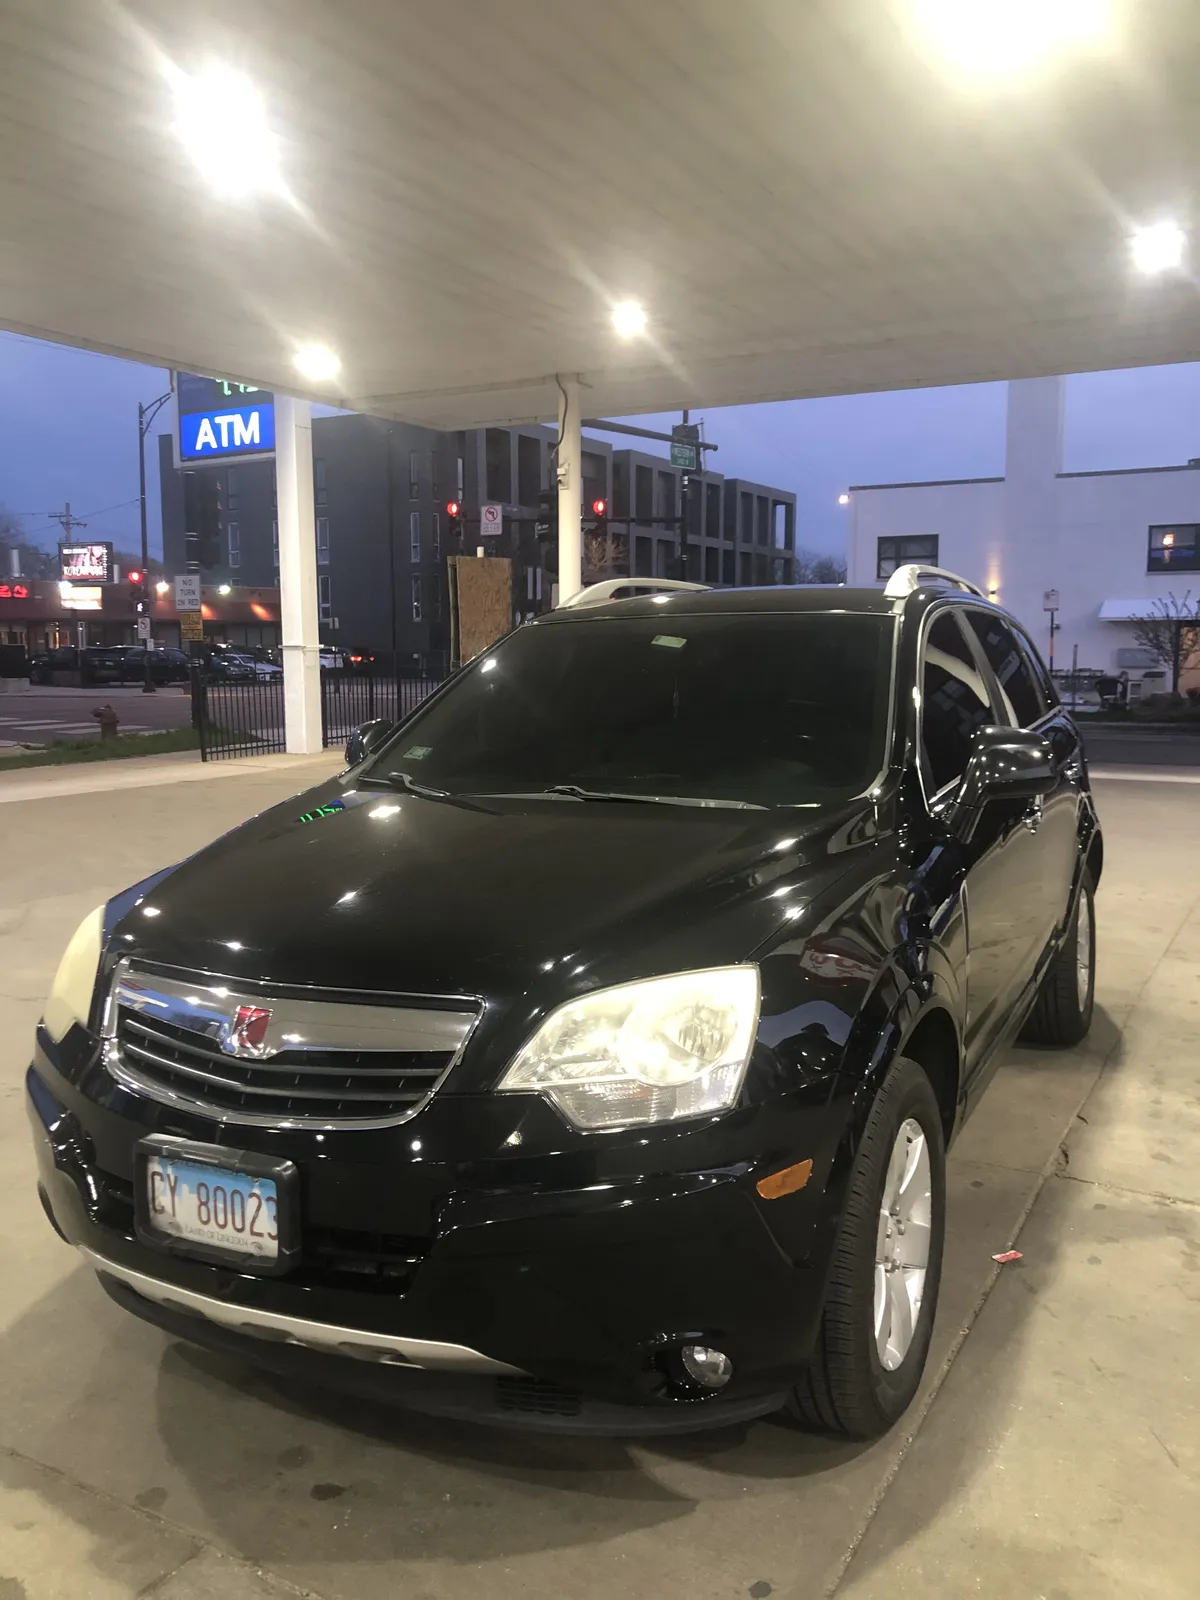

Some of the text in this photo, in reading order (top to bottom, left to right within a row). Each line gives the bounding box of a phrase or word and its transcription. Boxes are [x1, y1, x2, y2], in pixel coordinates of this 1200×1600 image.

[195, 411, 260, 451] ATM
[180, 589, 196, 597] TURN
[151, 1171, 279, 1241] CY 80023
